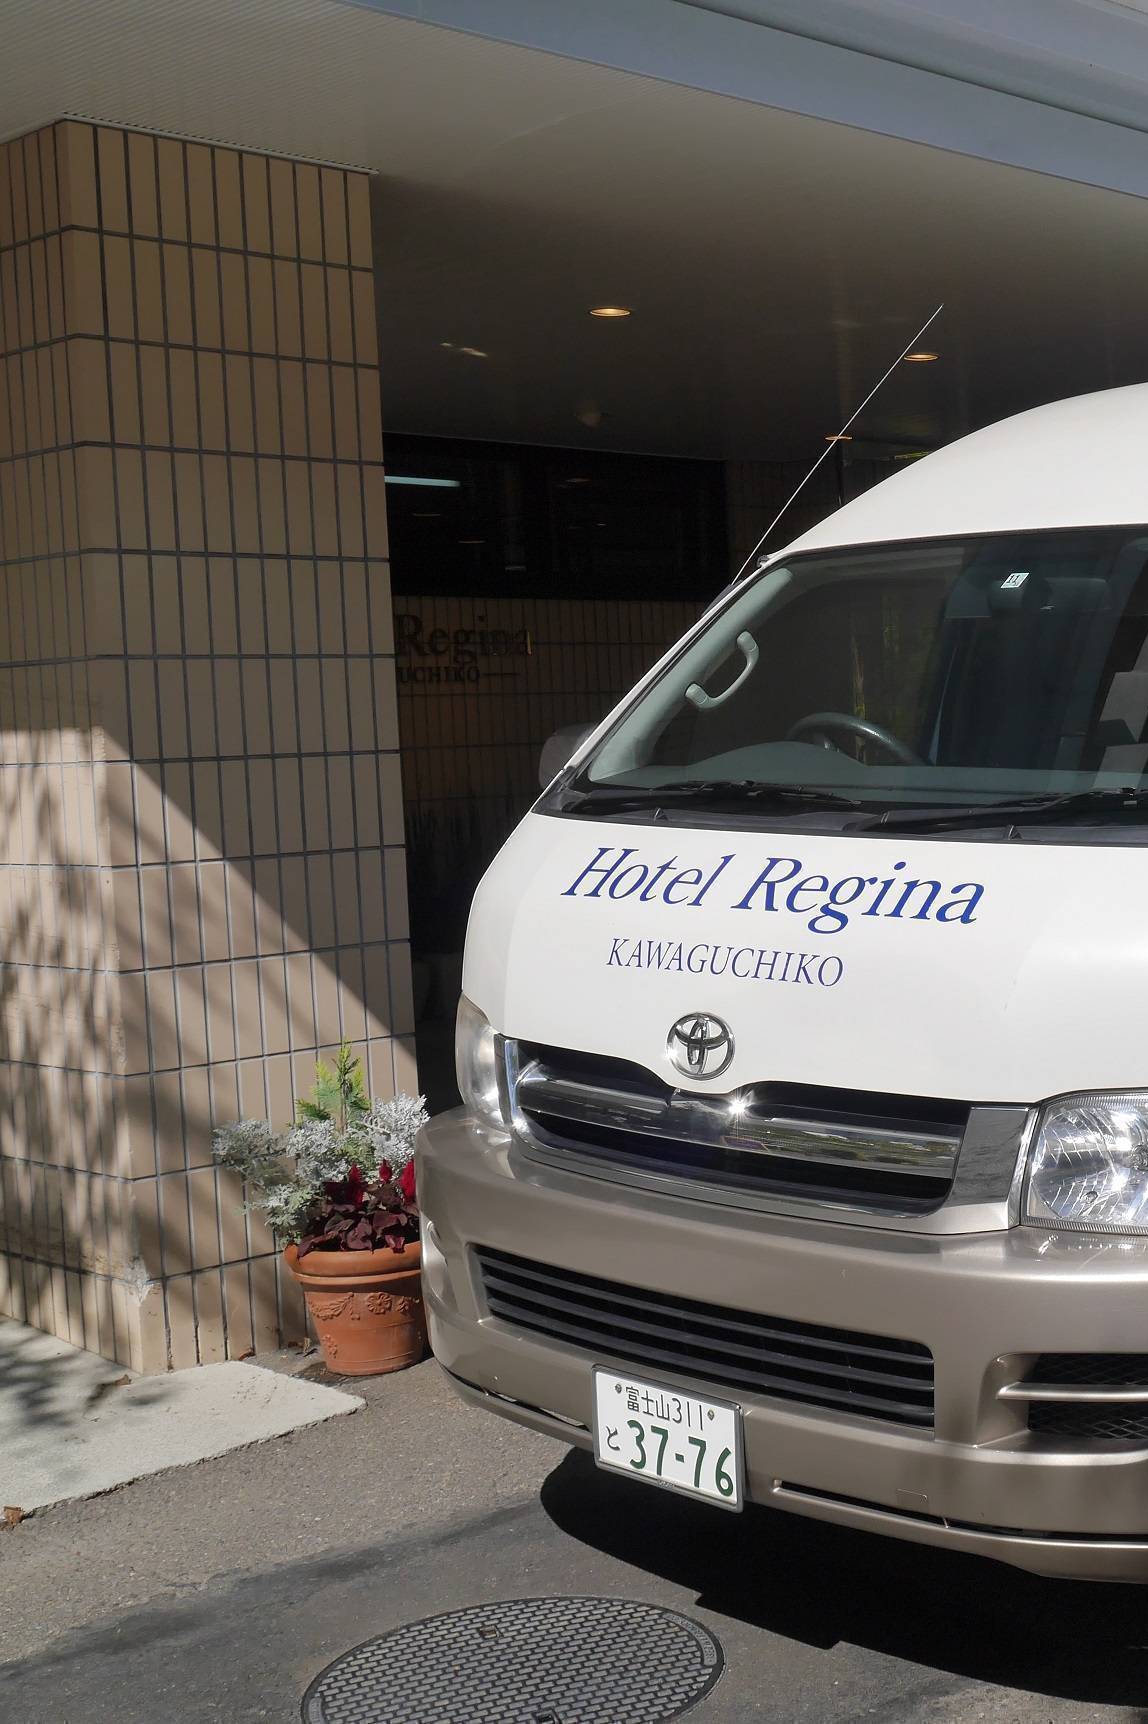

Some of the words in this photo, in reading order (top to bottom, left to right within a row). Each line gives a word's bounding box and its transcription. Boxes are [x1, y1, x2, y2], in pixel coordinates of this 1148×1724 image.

[395, 614, 533, 664] Regina
[560, 847, 737, 908] Hotel
[730, 857, 986, 935] Regina
[605, 938, 844, 987] KAWAGUCHIKO
[605, 1425, 621, 1451] と
[626, 1419, 734, 1498] 37-76
